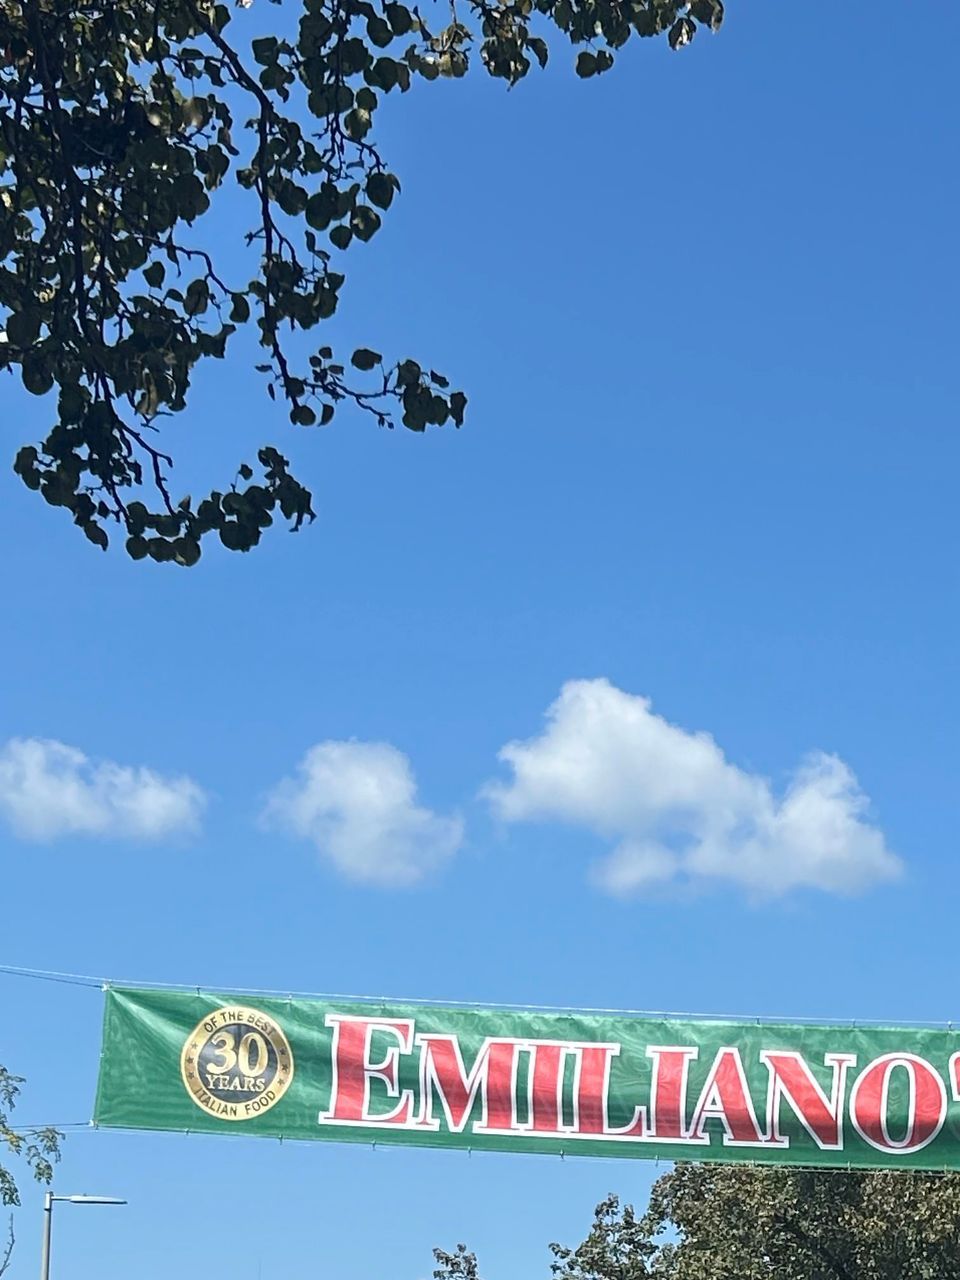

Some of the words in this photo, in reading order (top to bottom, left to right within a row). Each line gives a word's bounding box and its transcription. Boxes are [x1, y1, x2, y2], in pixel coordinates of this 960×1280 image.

[204, 1017, 218, 1033] OF
[220, 1011, 243, 1022] THE
[247, 1013, 274, 1036] BEST
[206, 1031, 268, 1077] 30
[205, 1074, 265, 1092] YEARS
[194, 1088, 237, 1116] ITALIAN
[245, 1090, 275, 1115] FOOD
